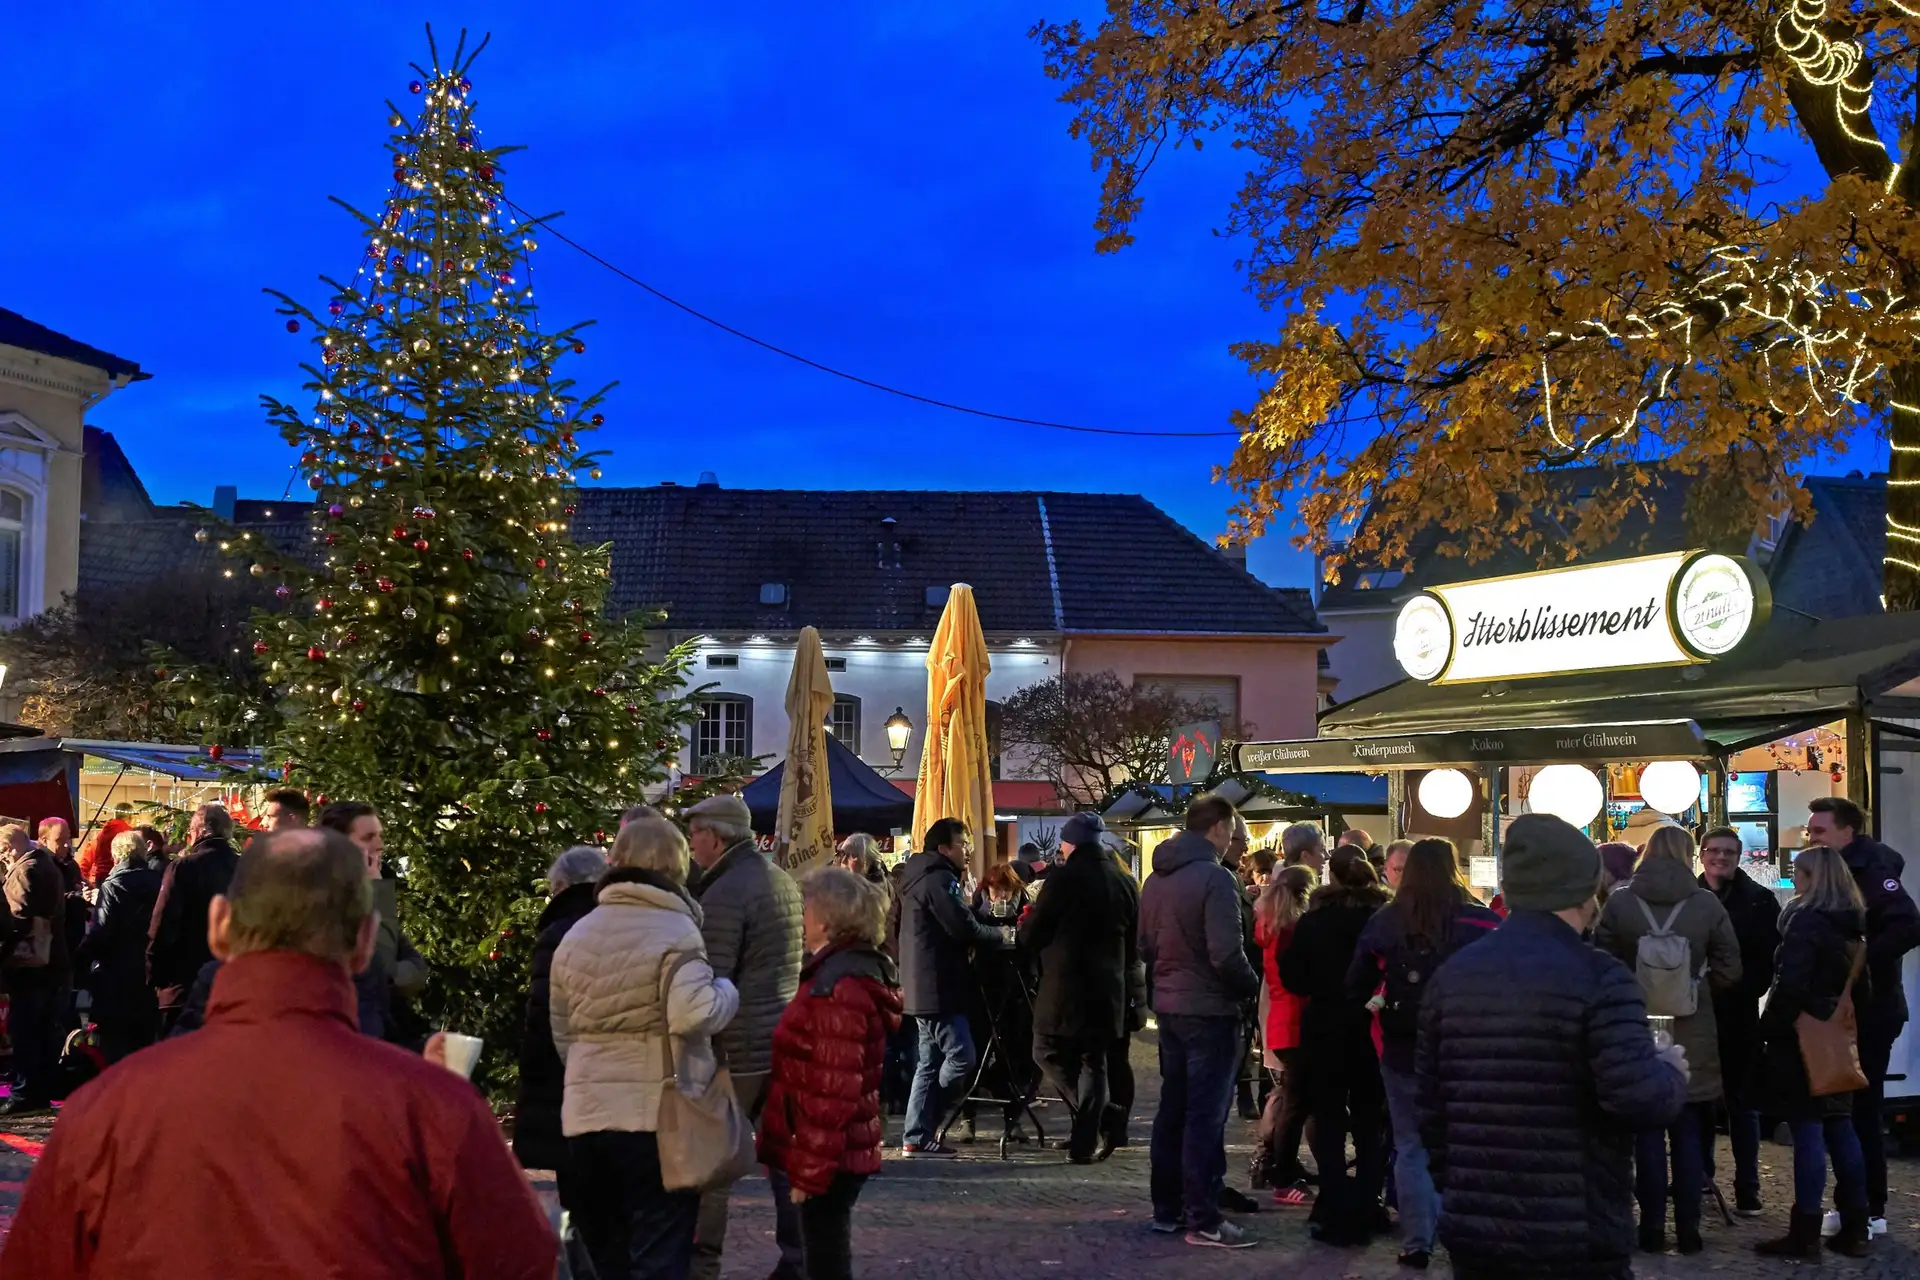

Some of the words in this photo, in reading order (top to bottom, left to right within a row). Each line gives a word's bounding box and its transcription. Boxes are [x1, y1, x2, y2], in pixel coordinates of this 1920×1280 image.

[1470, 737, 1504, 750] Kakao
[1556, 737, 1581, 749] roter
[1582, 732, 1638, 748] Glühwein
[1247, 749, 1272, 766] weißer
[1272, 746, 1311, 760] Glühwein
[1352, 741, 1416, 759] Kinderpunsch
